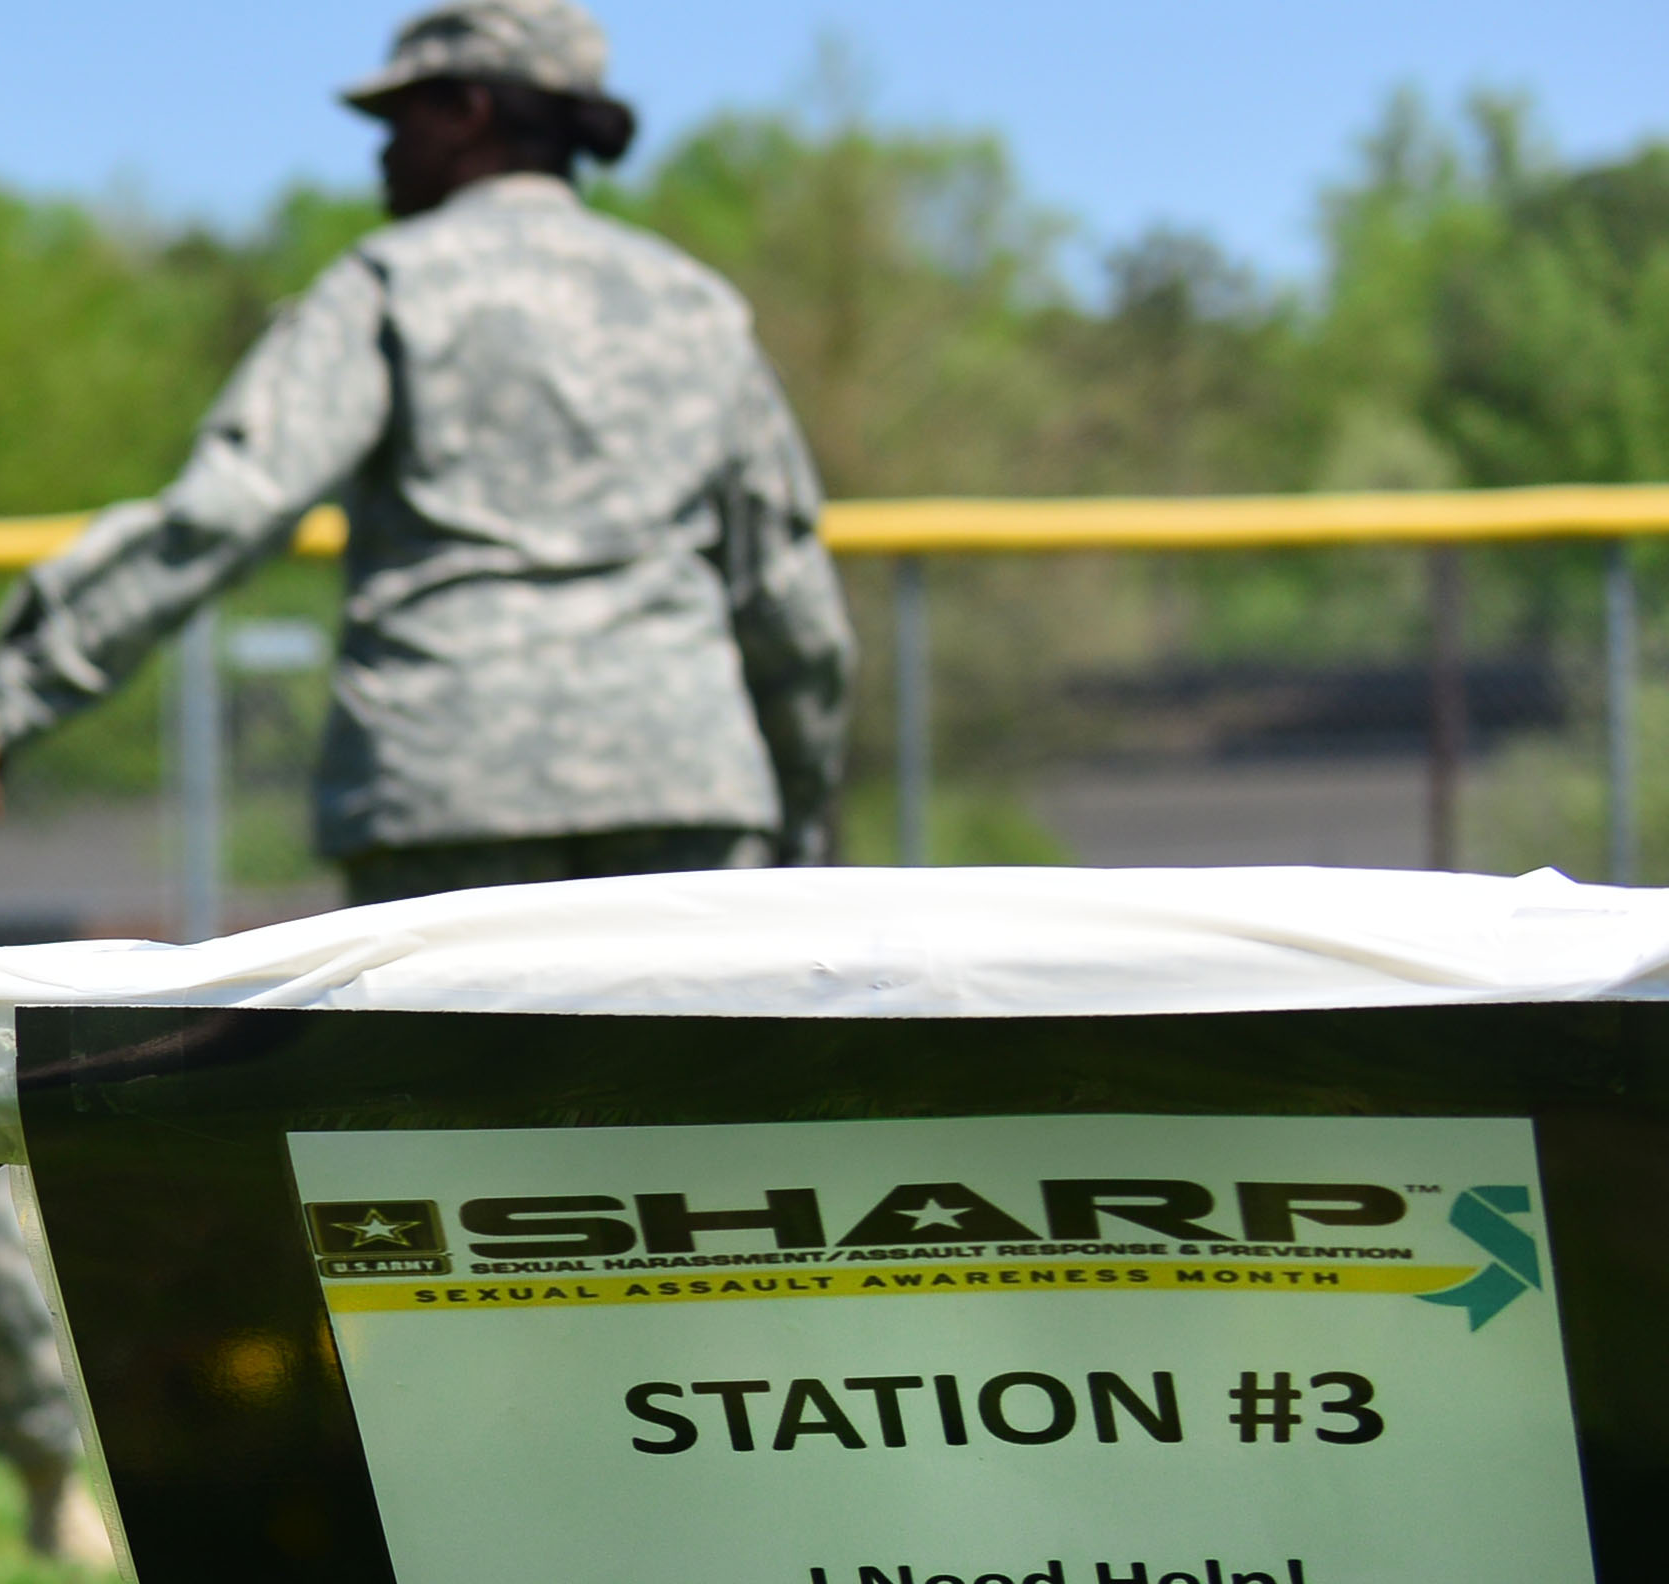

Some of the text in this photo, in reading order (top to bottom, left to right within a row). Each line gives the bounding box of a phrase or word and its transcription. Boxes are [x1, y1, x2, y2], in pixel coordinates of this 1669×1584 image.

[459, 1178, 1407, 1260] SHARP
[414, 1268, 1340, 1304] SEXUAL ASSAULT AWARENESS MONTH
[469, 1260, 595, 1275] SEXUAL
[996, 1242, 1168, 1257] RESPONSE
[1178, 1243, 1202, 1256] &
[1209, 1243, 1414, 1260] PREVENTION
[624, 1370, 1386, 1456] STATION #3
